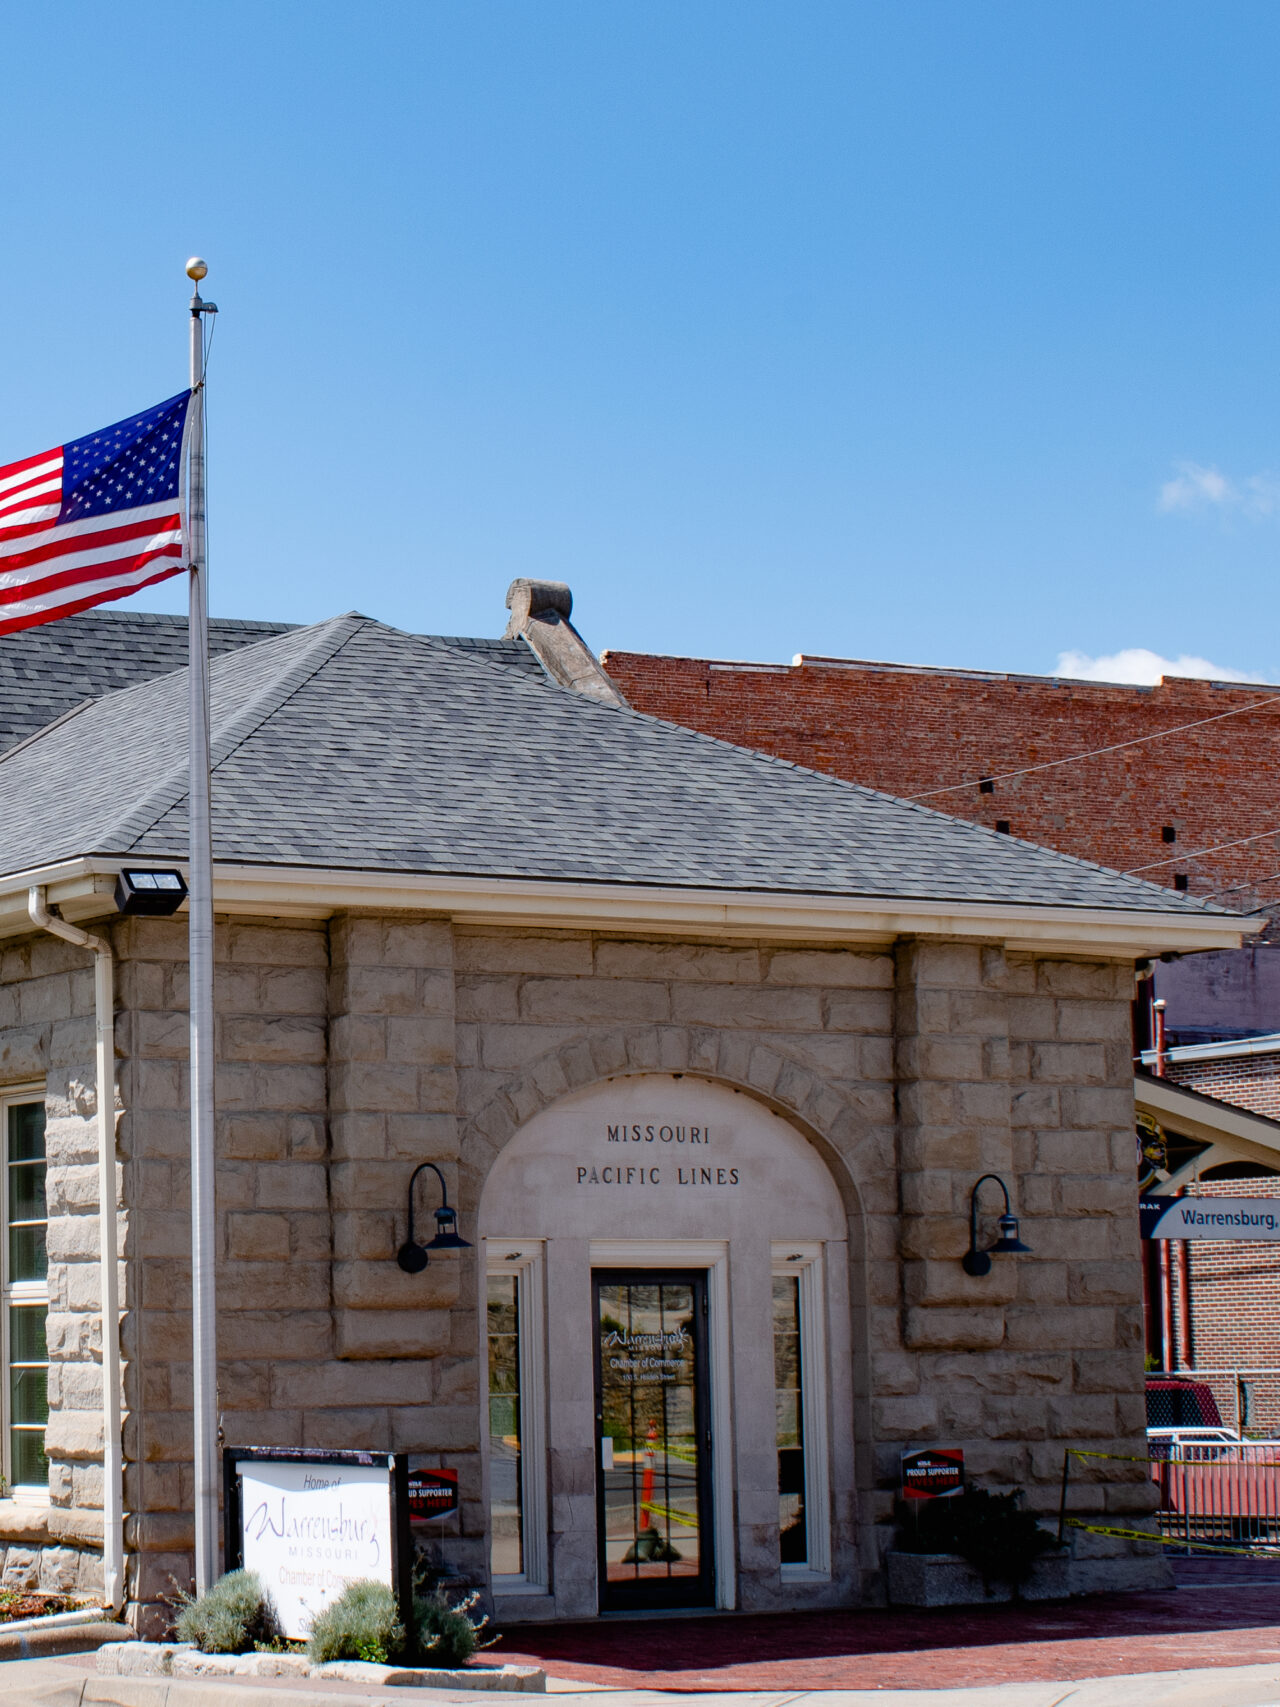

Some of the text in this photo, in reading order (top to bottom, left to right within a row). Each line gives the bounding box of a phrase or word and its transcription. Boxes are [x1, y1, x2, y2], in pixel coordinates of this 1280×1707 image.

[607, 1125, 710, 1144] MISSOURI
[576, 1166, 740, 1185] PACIFIC LINES
[1181, 1209, 1279, 1230] Warrensburg,
[604, 1327, 688, 1352] Warrensburg
[610, 1357, 640, 1369] Chamber
[641, 1357, 649, 1368] of
[906, 1467, 959, 1477] PROUD SUPPORTER
[303, 1474, 342, 1492] Home of
[908, 1476, 960, 1487] LIVES HERE
[419, 1488, 453, 1497] SUPPORTER
[427, 1498, 453, 1508] HERE
[245, 1496, 380, 1567] Warrensburg
[289, 1546, 359, 1560] MISSOURI
[279, 1566, 316, 1587] Chamber
[317, 1567, 325, 1587] of
